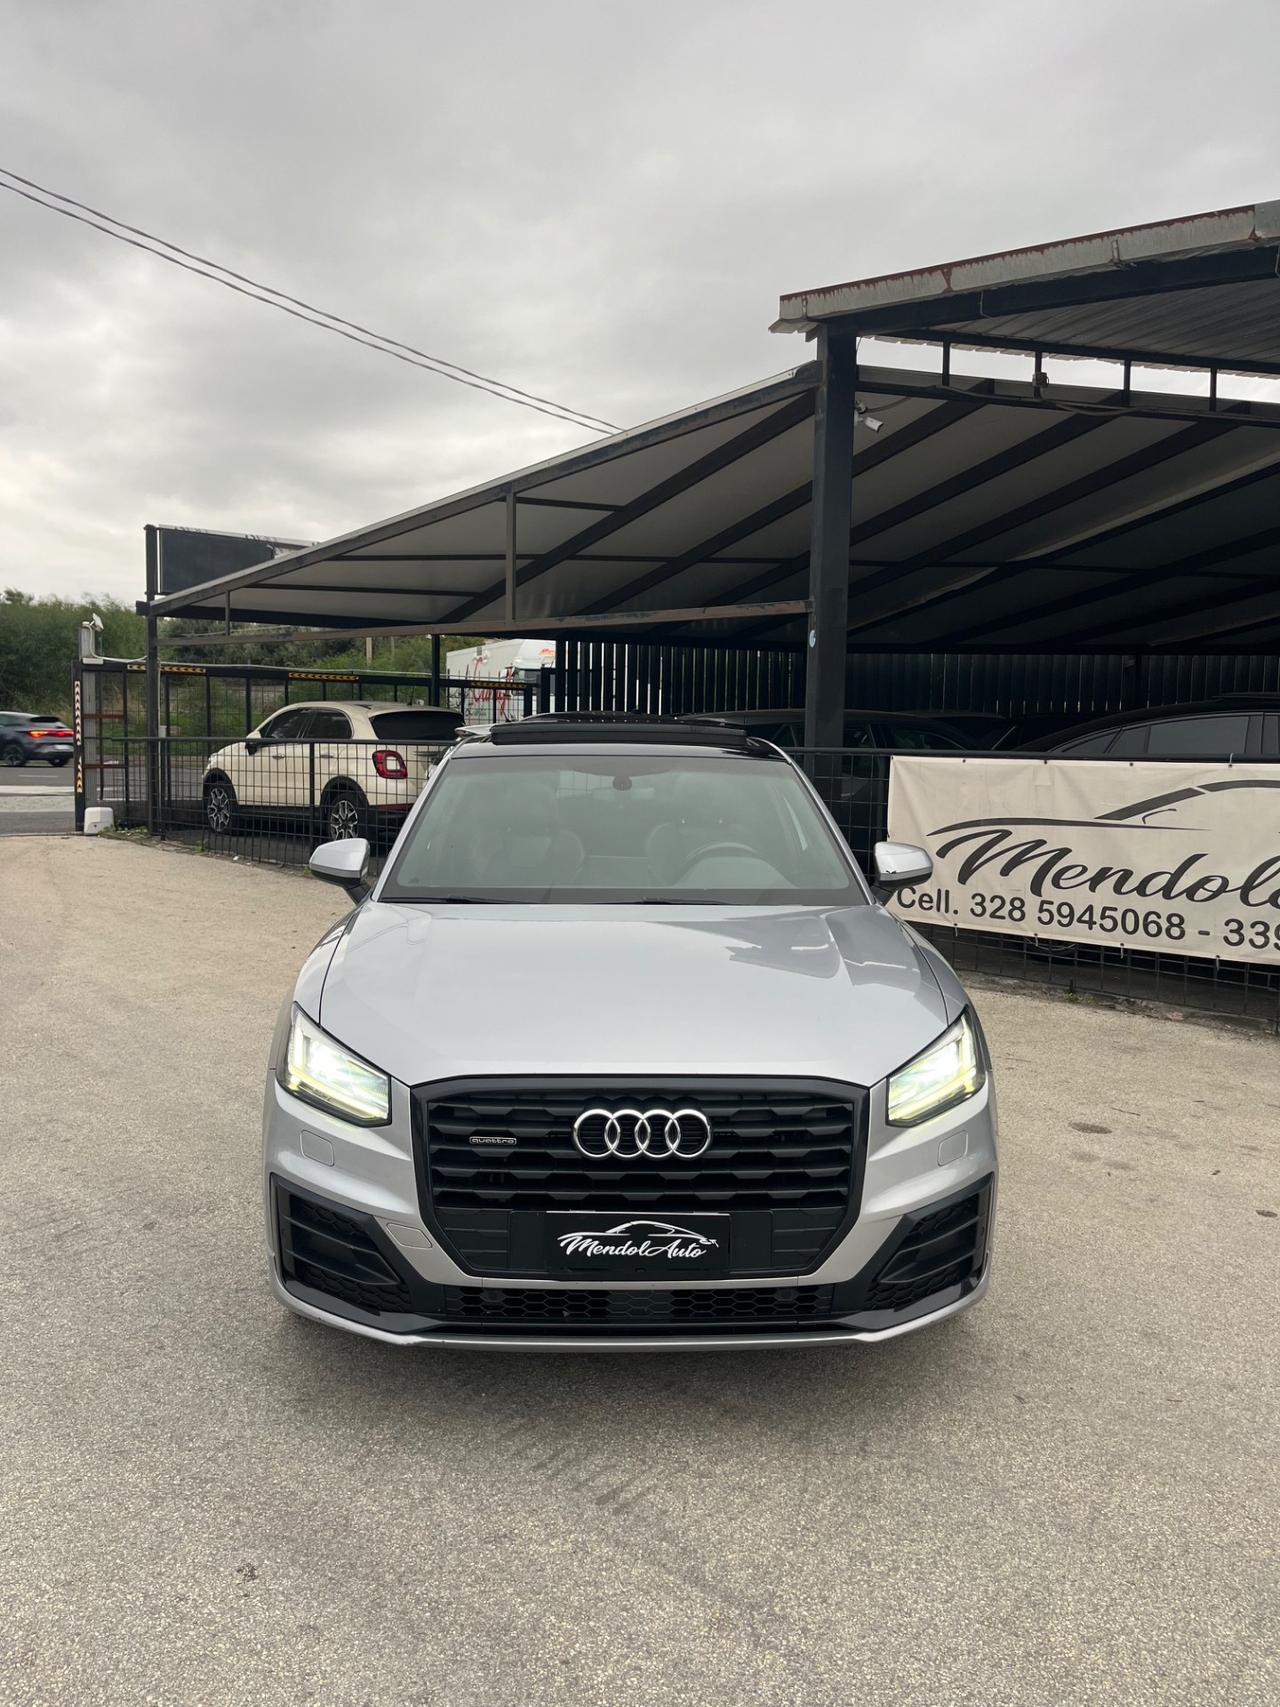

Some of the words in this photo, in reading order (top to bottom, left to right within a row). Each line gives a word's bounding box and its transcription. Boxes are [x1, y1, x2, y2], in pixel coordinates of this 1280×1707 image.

[936, 829, 1280, 910] Mendol
[896, 886, 960, 915] Cell.
[970, 892, 1026, 922] 328
[1037, 900, 1186, 941] 5945068
[470, 1137, 515, 1145] quattro
[559, 1235, 707, 1259] MendolAuto
